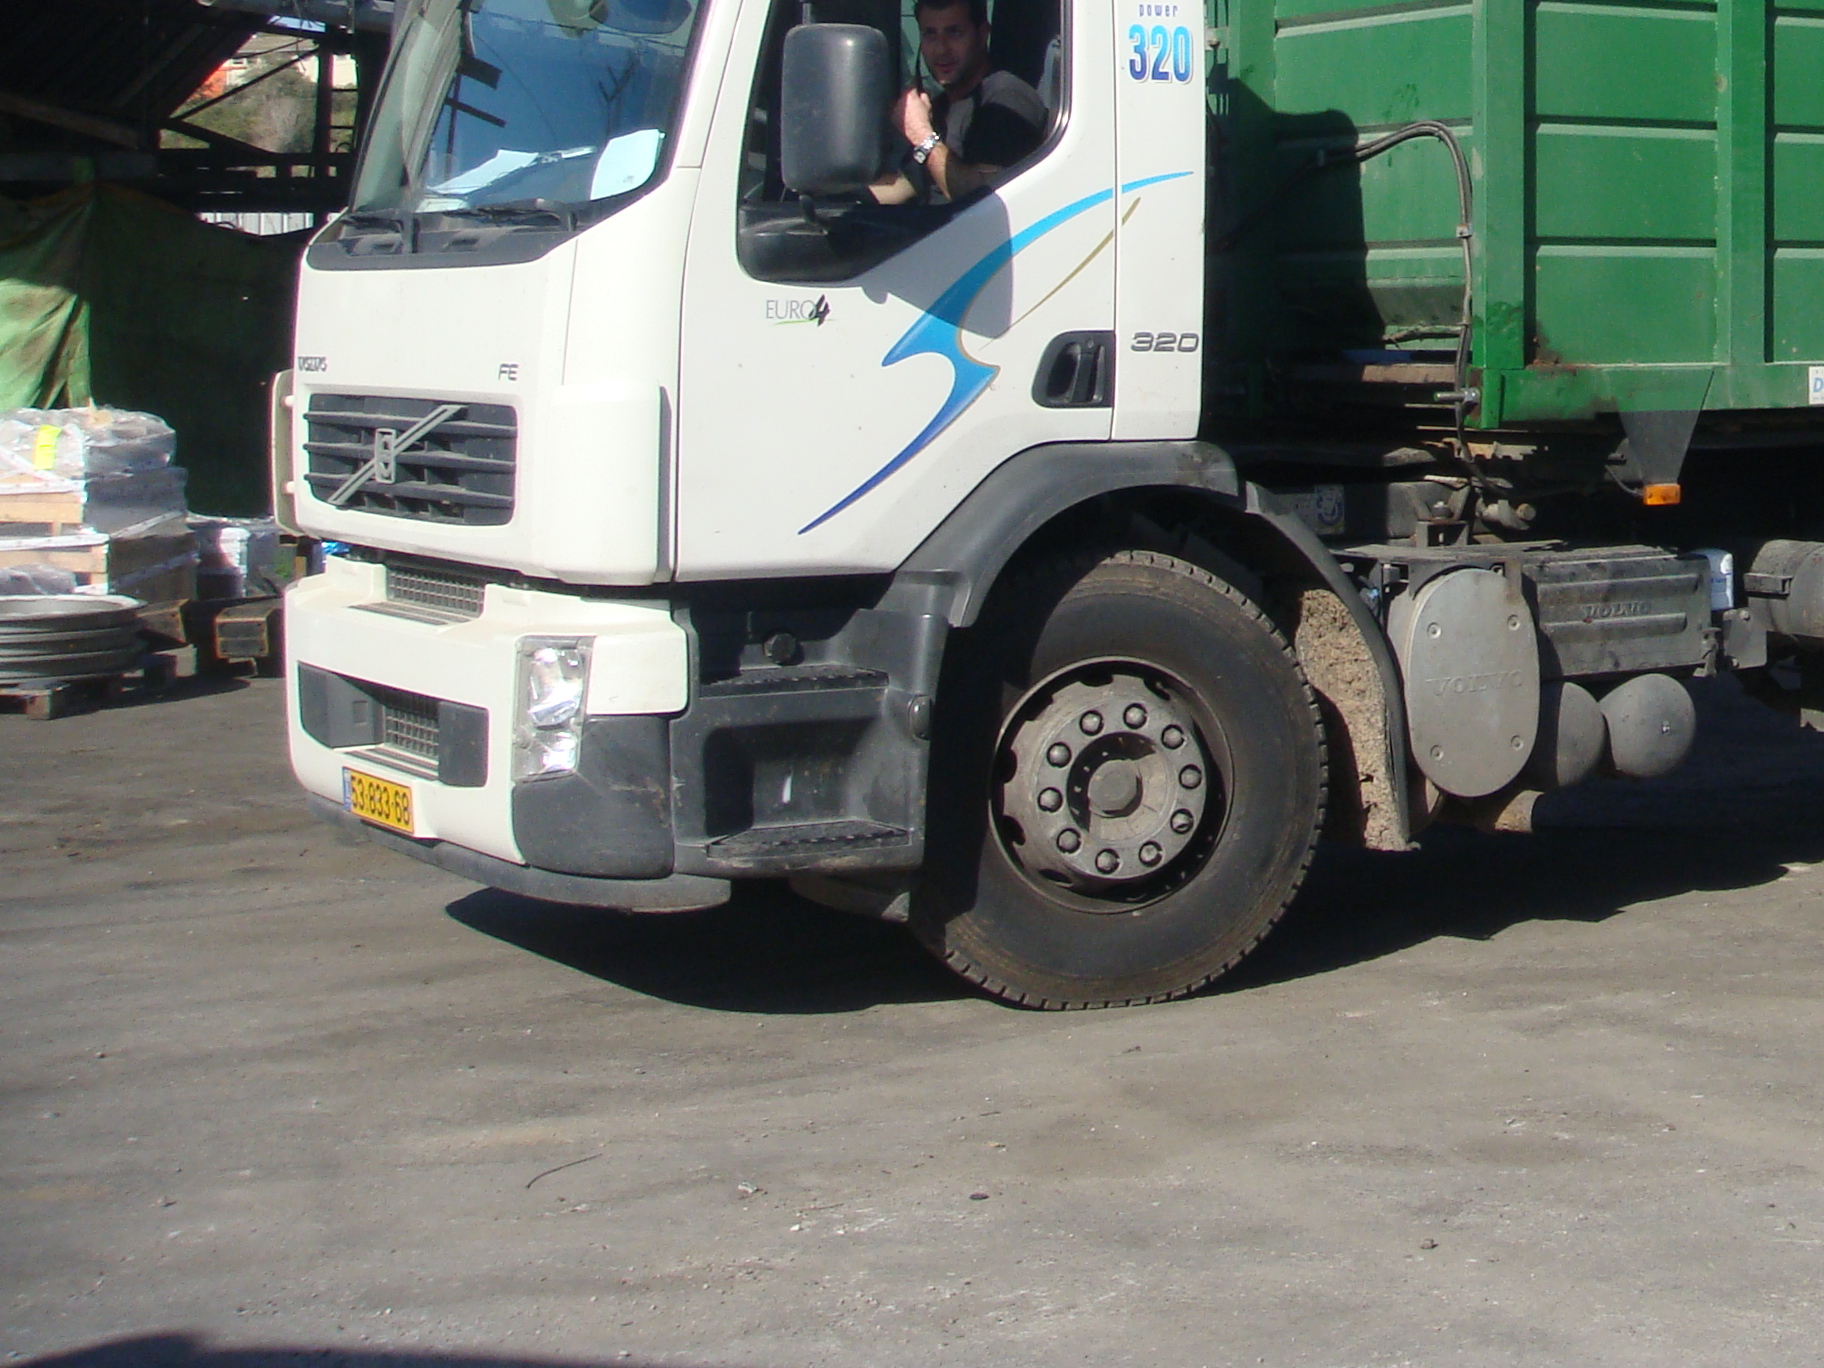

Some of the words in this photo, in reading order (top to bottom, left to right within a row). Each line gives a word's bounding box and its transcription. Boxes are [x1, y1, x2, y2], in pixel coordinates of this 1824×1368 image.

[1138, 3, 1178, 18] power
[1128, 23, 1192, 83] 320
[1130, 331, 1199, 352] 320
[498, 363, 519, 382] FE
